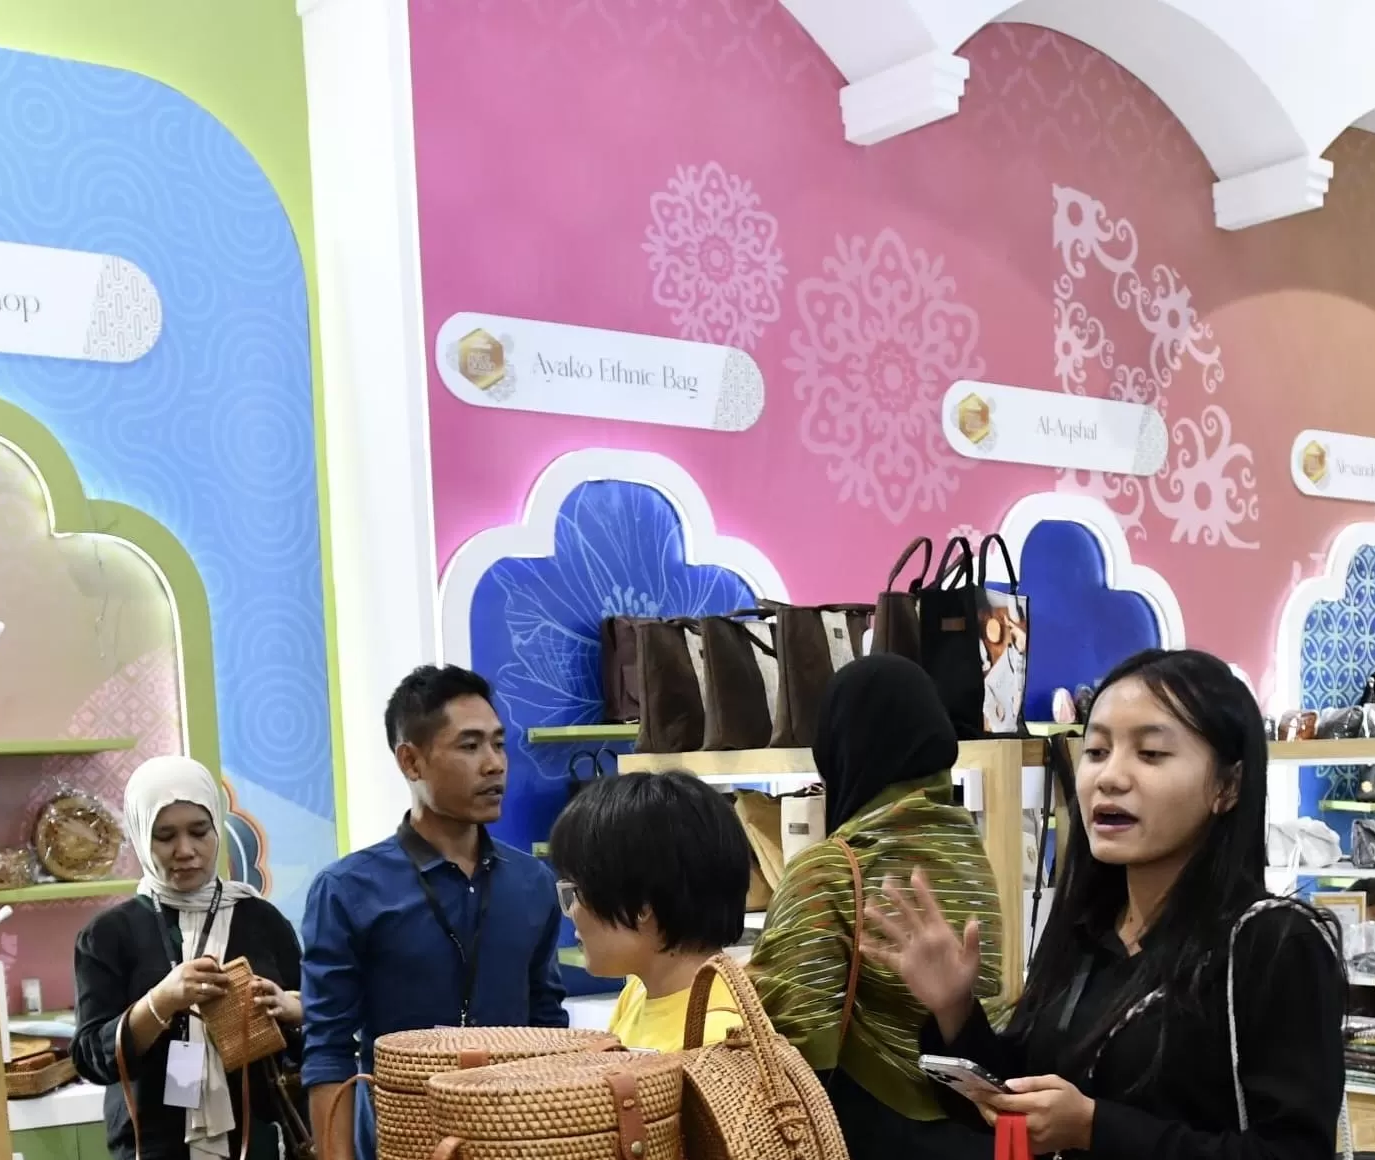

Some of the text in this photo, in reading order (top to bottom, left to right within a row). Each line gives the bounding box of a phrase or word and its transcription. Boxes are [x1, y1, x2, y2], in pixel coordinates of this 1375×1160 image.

[531, 351, 698, 399] Ayako Ethnic Bag
